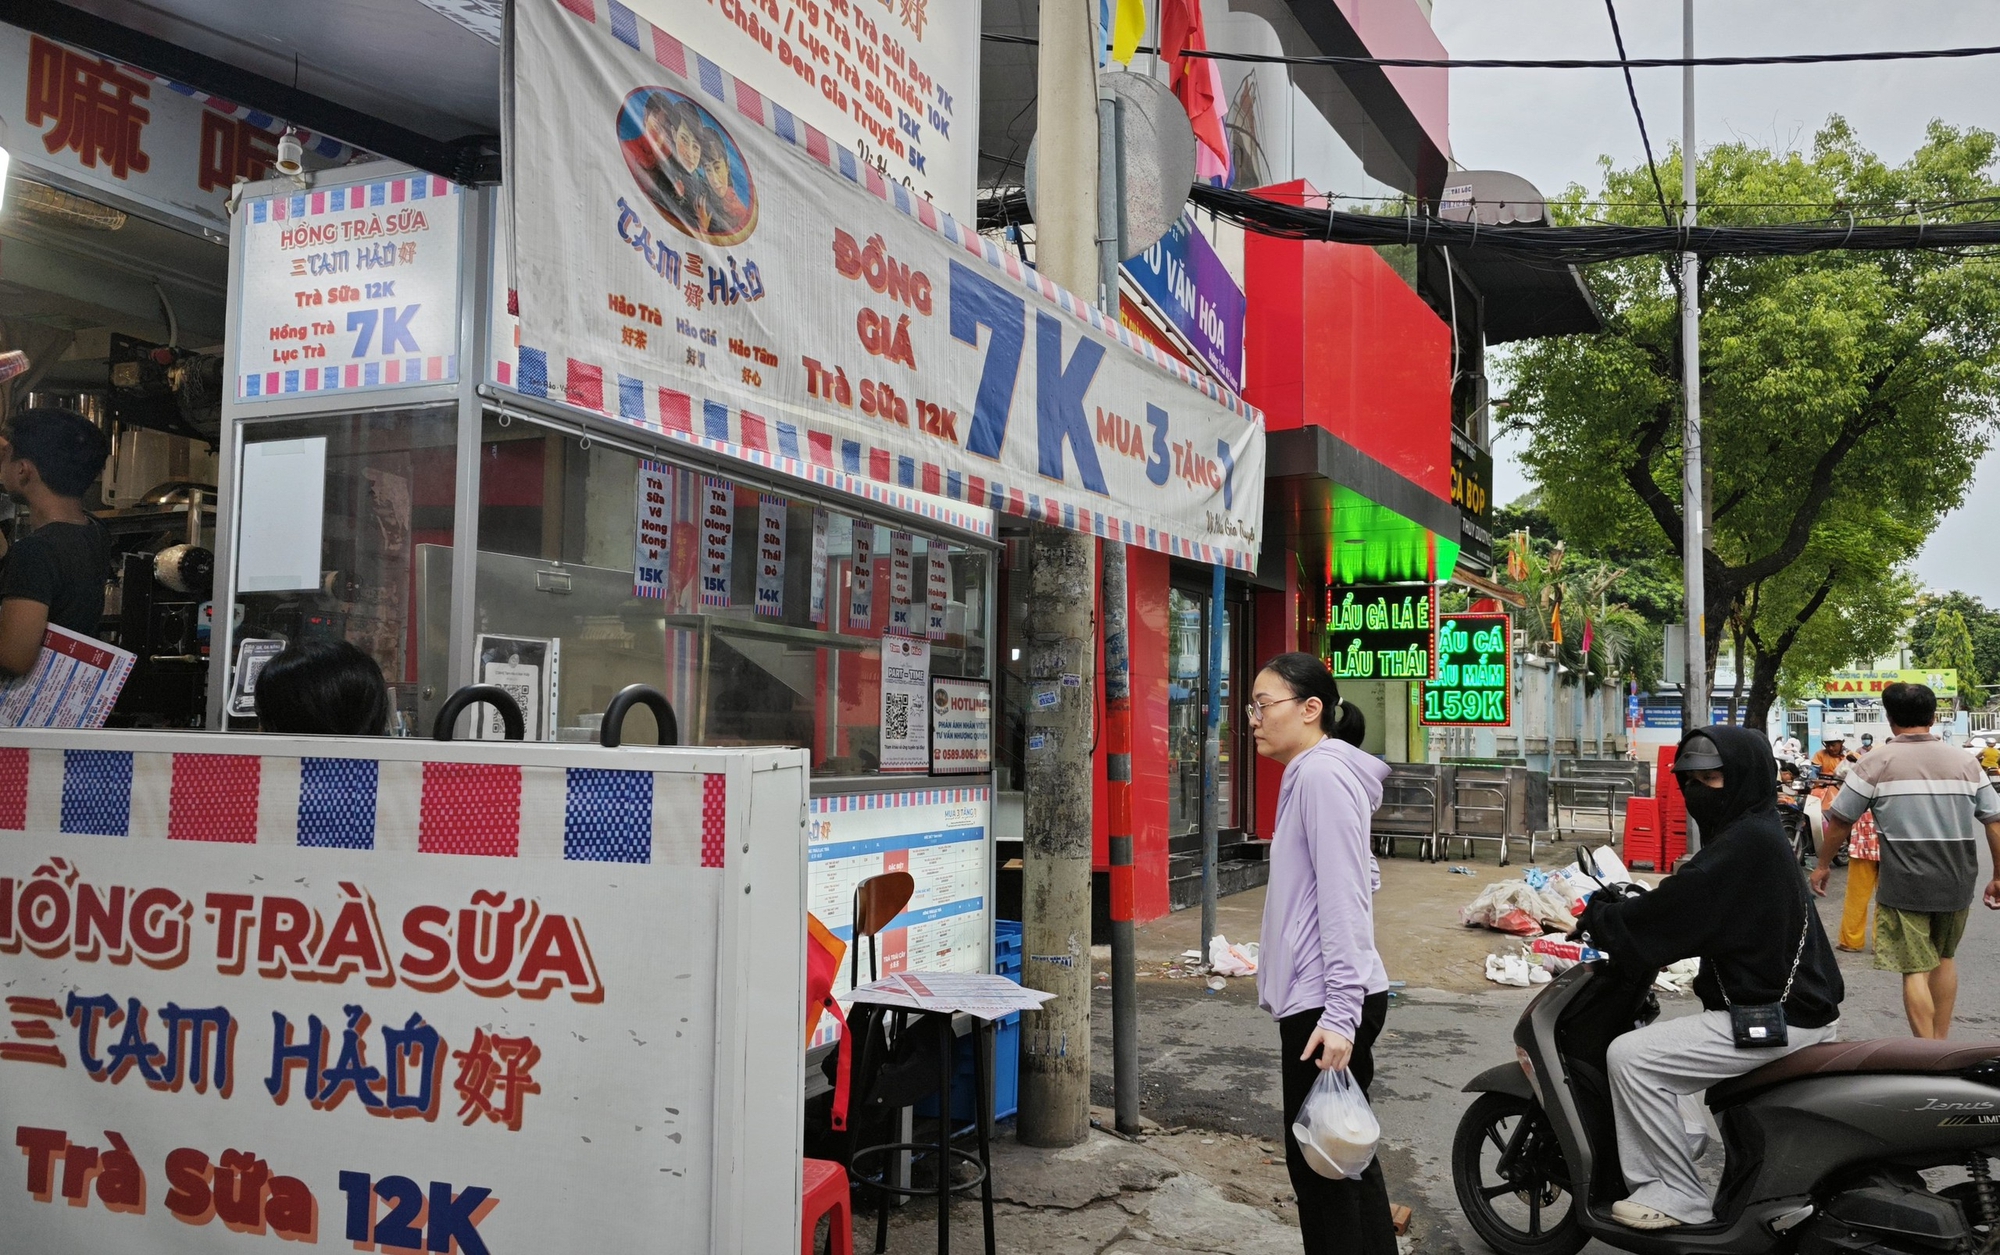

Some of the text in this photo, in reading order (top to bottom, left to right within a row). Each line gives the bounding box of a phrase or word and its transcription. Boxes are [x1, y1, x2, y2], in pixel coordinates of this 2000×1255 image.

[853, 3, 953, 117] Trà Sủi Bọt 7K
[799, 19, 830, 65] Lục
[834, 50, 860, 93] Trà
[865, 79, 893, 121] Sữa
[897, 106, 922, 146] 12K
[824, 8, 851, 54] Trà
[855, 36, 880, 79] Vải
[927, 102, 951, 142] 10K
[720, 0, 773, 54] Châu
[778, 37, 815, 88] Đen
[820, 74, 848, 114] Gia
[852, 97, 905, 160] Truyền
[908, 144, 926, 178] 5K
[281, 208, 429, 250] HỒNG TRÀ SỮA
[290, 258, 307, 277] 三
[356, 241, 397, 270] HẢO
[398, 241, 417, 265] 好
[707, 255, 765, 306] HẢO
[833, 226, 932, 317] ĐỒNG
[295, 280, 396, 307] Trà Sữa 12K
[1166, 249, 1196, 320] VĂN
[1199, 294, 1225, 356] HÓA
[608, 293, 663, 327] Hảo Trà
[269, 320, 336, 341] Hồng Trà
[346, 303, 422, 359] 7K
[621, 325, 648, 350] 好茶
[676, 317, 717, 347] Hảo Giá
[856, 306, 917, 371] GIÁ
[273, 343, 326, 364] Lục Trà
[728, 337, 778, 367] Hảo Tâm
[741, 366, 762, 388] 好心
[948, 258, 1110, 499] 7K
[802, 355, 959, 444] Trà Sữa 12K
[1096, 401, 1235, 511] MUA 3 TẶNG 1
[646, 478, 663, 491] Trà
[646, 492, 665, 505] Sữa
[711, 490, 726, 502] Trà
[709, 505, 727, 517] Sữa
[641, 519, 668, 535] Hong
[704, 518, 732, 534] Olong
[766, 518, 780, 530] Trà
[641, 533, 667, 549] Kong
[708, 534, 728, 546] Quế
[764, 533, 781, 546] Sữa
[857, 539, 869, 551] Trà
[649, 549, 658, 560] M
[708, 549, 726, 561] Hoa
[762, 549, 781, 562] Thái
[859, 552, 867, 564] Bí
[639, 567, 664, 584] 15K
[712, 564, 720, 574] M
[764, 565, 777, 577] Đỏ
[704, 576, 726, 592] 15K
[758, 588, 780, 603] 14K
[852, 603, 868, 616] 10K
[894, 611, 907, 623] 5K
[930, 603, 943, 612] Kim
[1332, 592, 1429, 630] LẨU GÀ LÁ É
[930, 617, 942, 628] 3K
[1439, 620, 1505, 654] ẨU CÁ
[1333, 638, 1427, 678] LẨU THÁI
[888, 666, 904, 679] PART
[909, 669, 924, 680] TIME
[1463, 654, 1505, 687] MẮM
[1881, 671, 1898, 679] GIÁO
[1825, 681, 1863, 692] MAI
[951, 697, 987, 711] HOTLINE
[1425, 691, 1505, 720] 159K
[206, 881, 397, 988] TRÀ
[399, 888, 604, 1004] SỮA
[0, 996, 66, 1067] 三
[265, 1003, 448, 1122] HẢO
[452, 1027, 541, 1131] 好
[1914, 1098, 1994, 1111] Janus
[16, 1125, 500, 1255] Trà Sữa 12K
